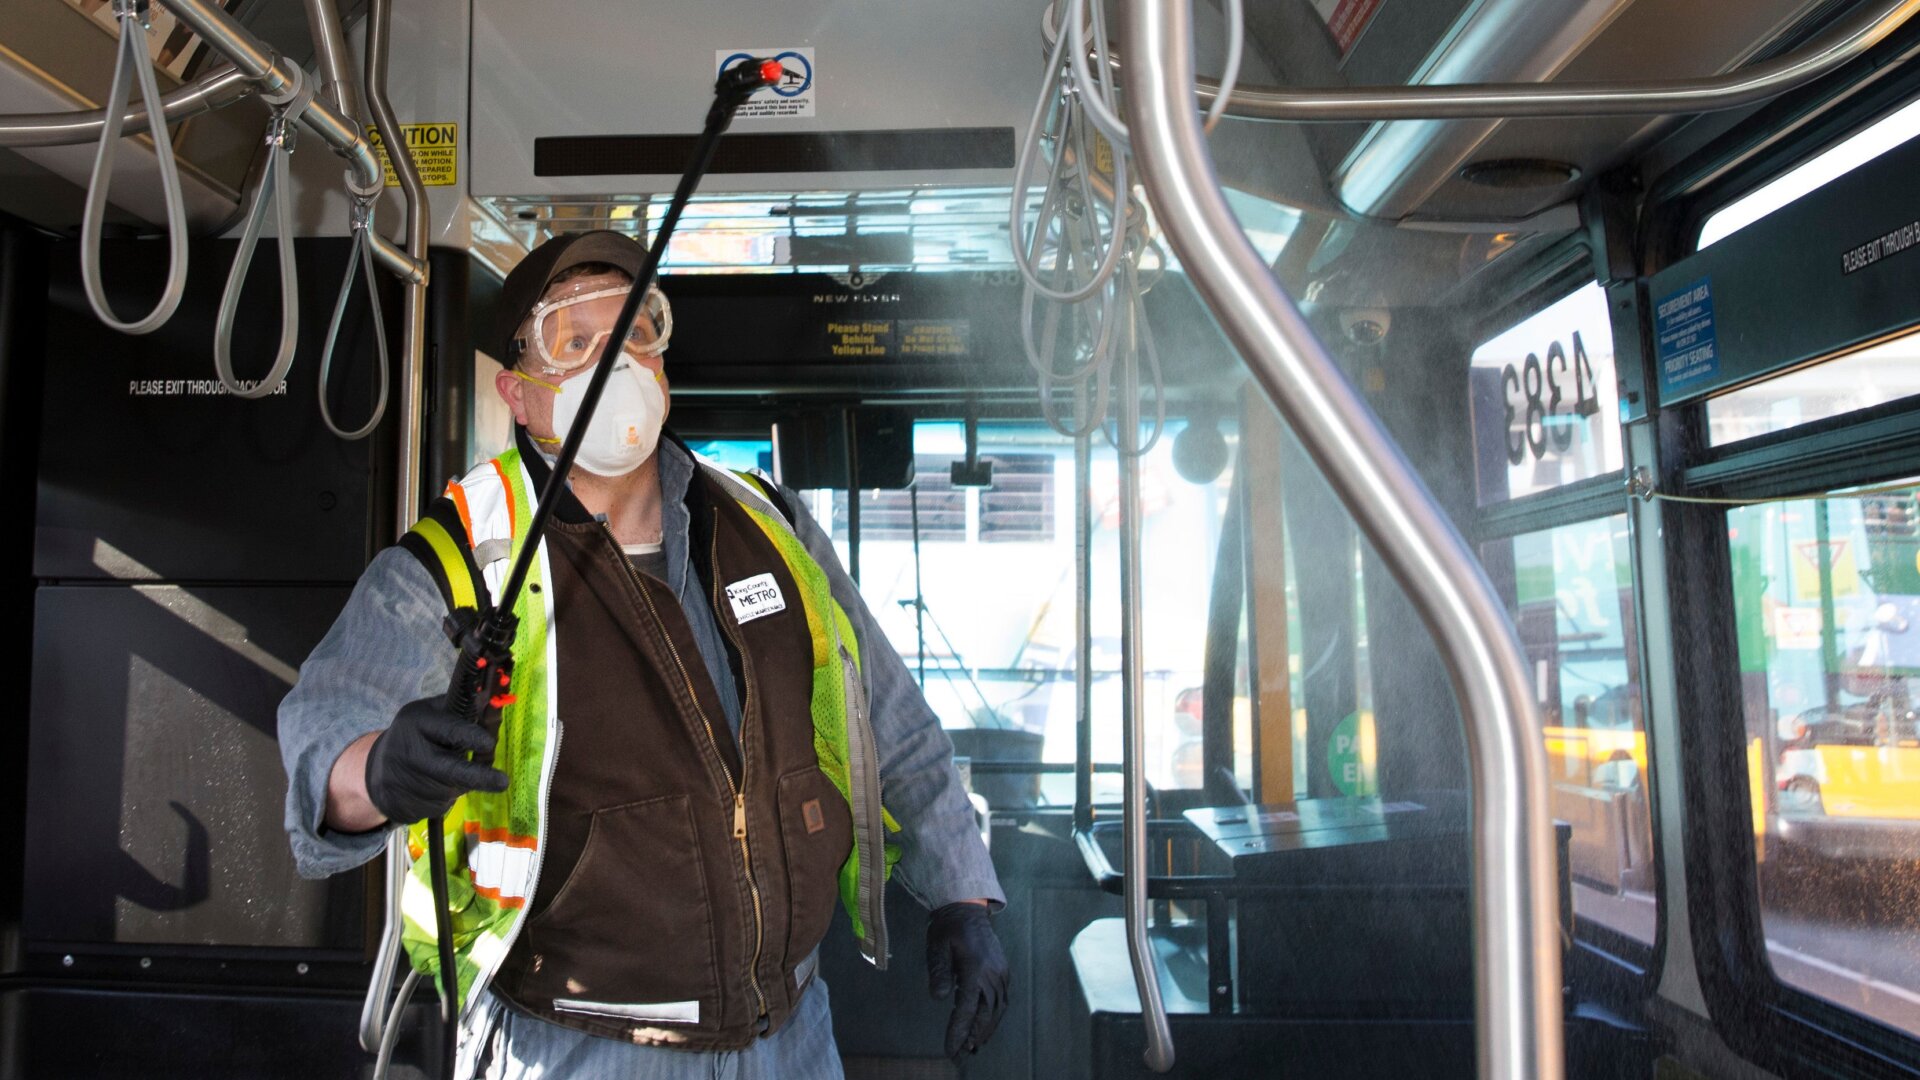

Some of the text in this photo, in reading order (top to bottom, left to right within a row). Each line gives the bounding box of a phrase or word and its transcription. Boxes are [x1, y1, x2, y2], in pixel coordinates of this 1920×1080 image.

[368, 127, 455, 146] CTION
[1843, 246, 1867, 274] PLEASE
[1867, 239, 1881, 263] EXIT
[1881, 223, 1915, 257] THROUGH
[813, 294, 900, 303] NEW FLYER
[827, 323, 889, 333] Please Stand
[842, 334, 875, 344] Behind
[832, 345, 885, 354] Yellow Line
[129, 380, 163, 394] PLEASE
[165, 380, 185, 394] EXIT
[747, 581, 768, 590] County
[739, 588, 777, 607] METRO
